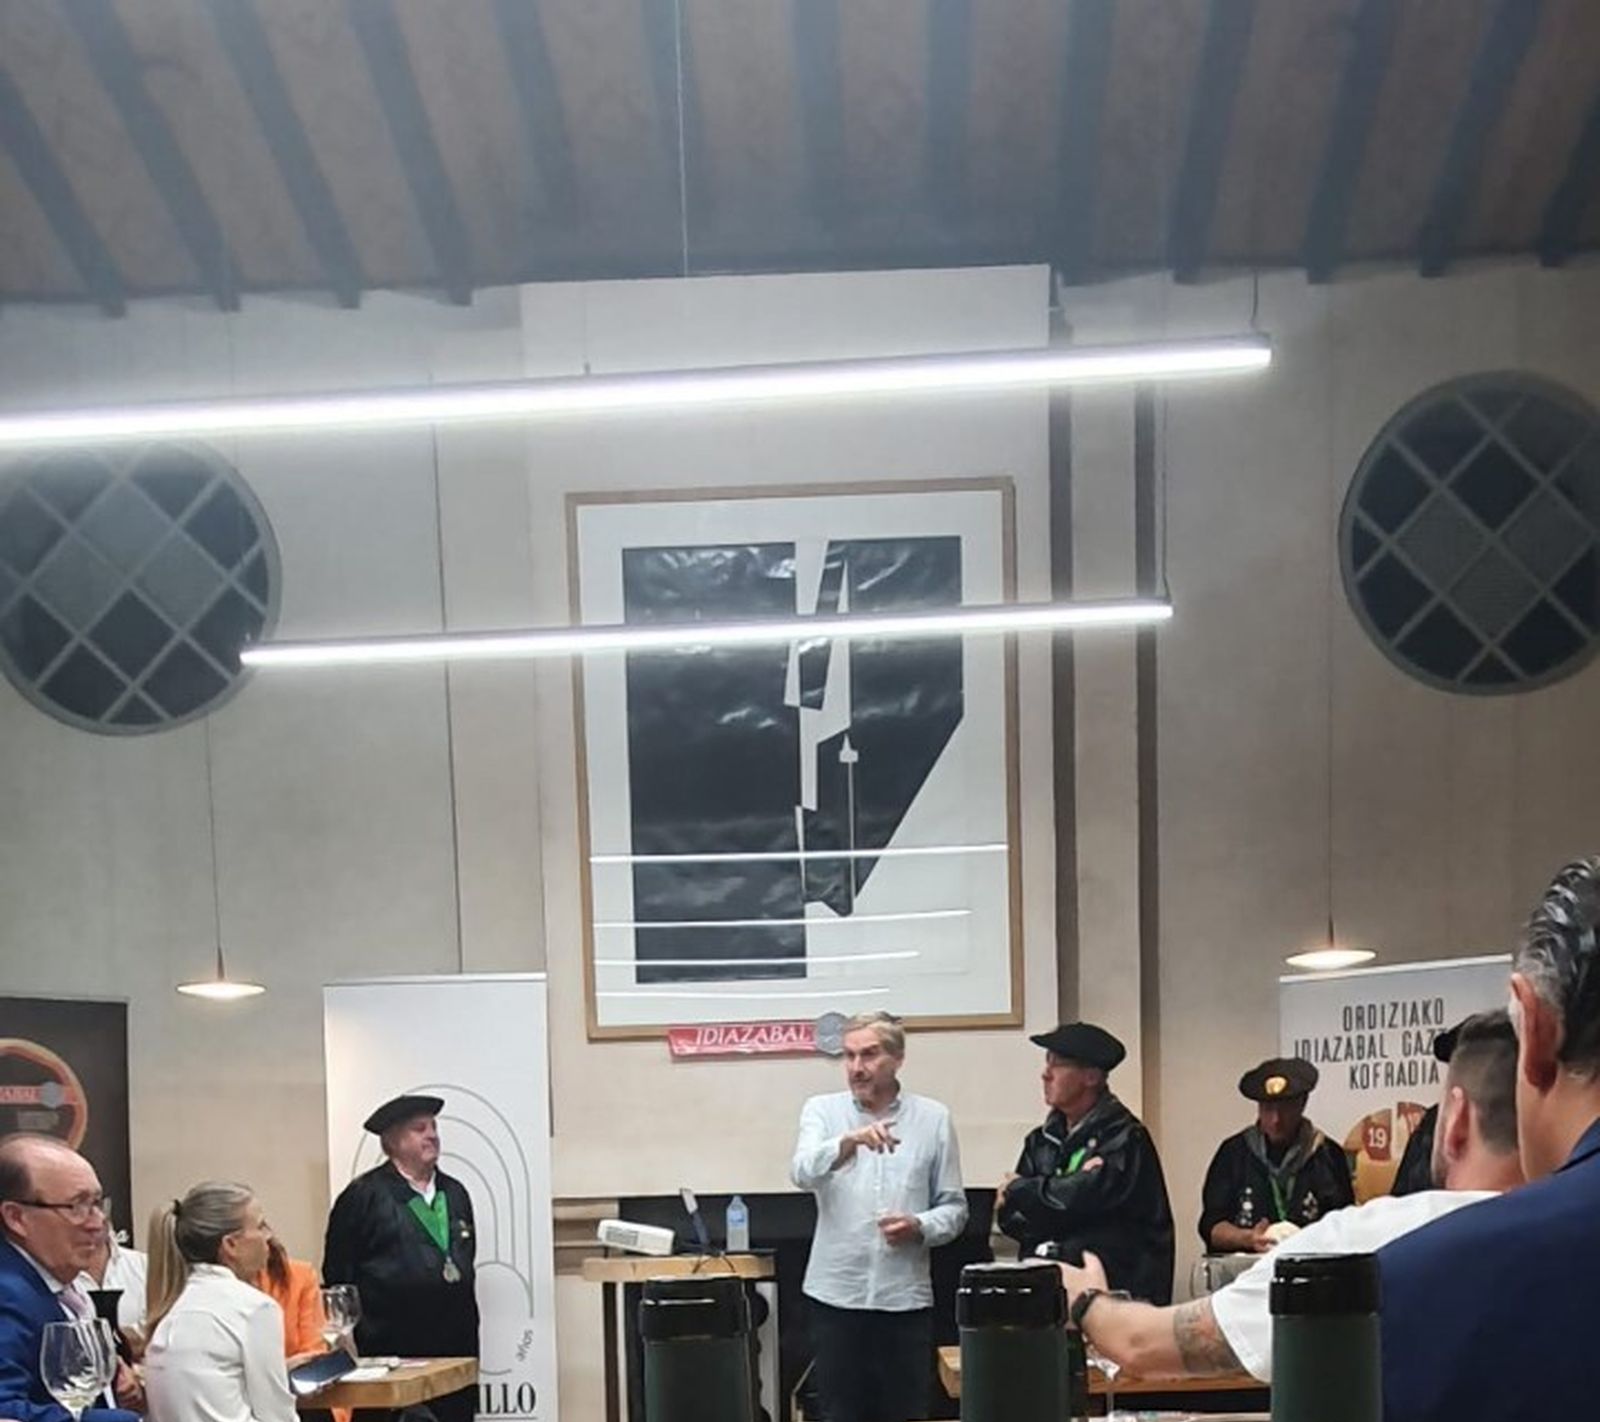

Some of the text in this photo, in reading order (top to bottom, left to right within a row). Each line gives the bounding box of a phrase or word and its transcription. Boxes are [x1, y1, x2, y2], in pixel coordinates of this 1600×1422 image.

[1342, 998, 1444, 1031] ORDIZIAKO
[696, 1025, 811, 1047] IDIAZABAL
[1294, 1027, 1447, 1063] IDIAZABAL GAZ
[1350, 1060, 1440, 1090] KOFRADIA
[1367, 1126, 1388, 1149] 19
